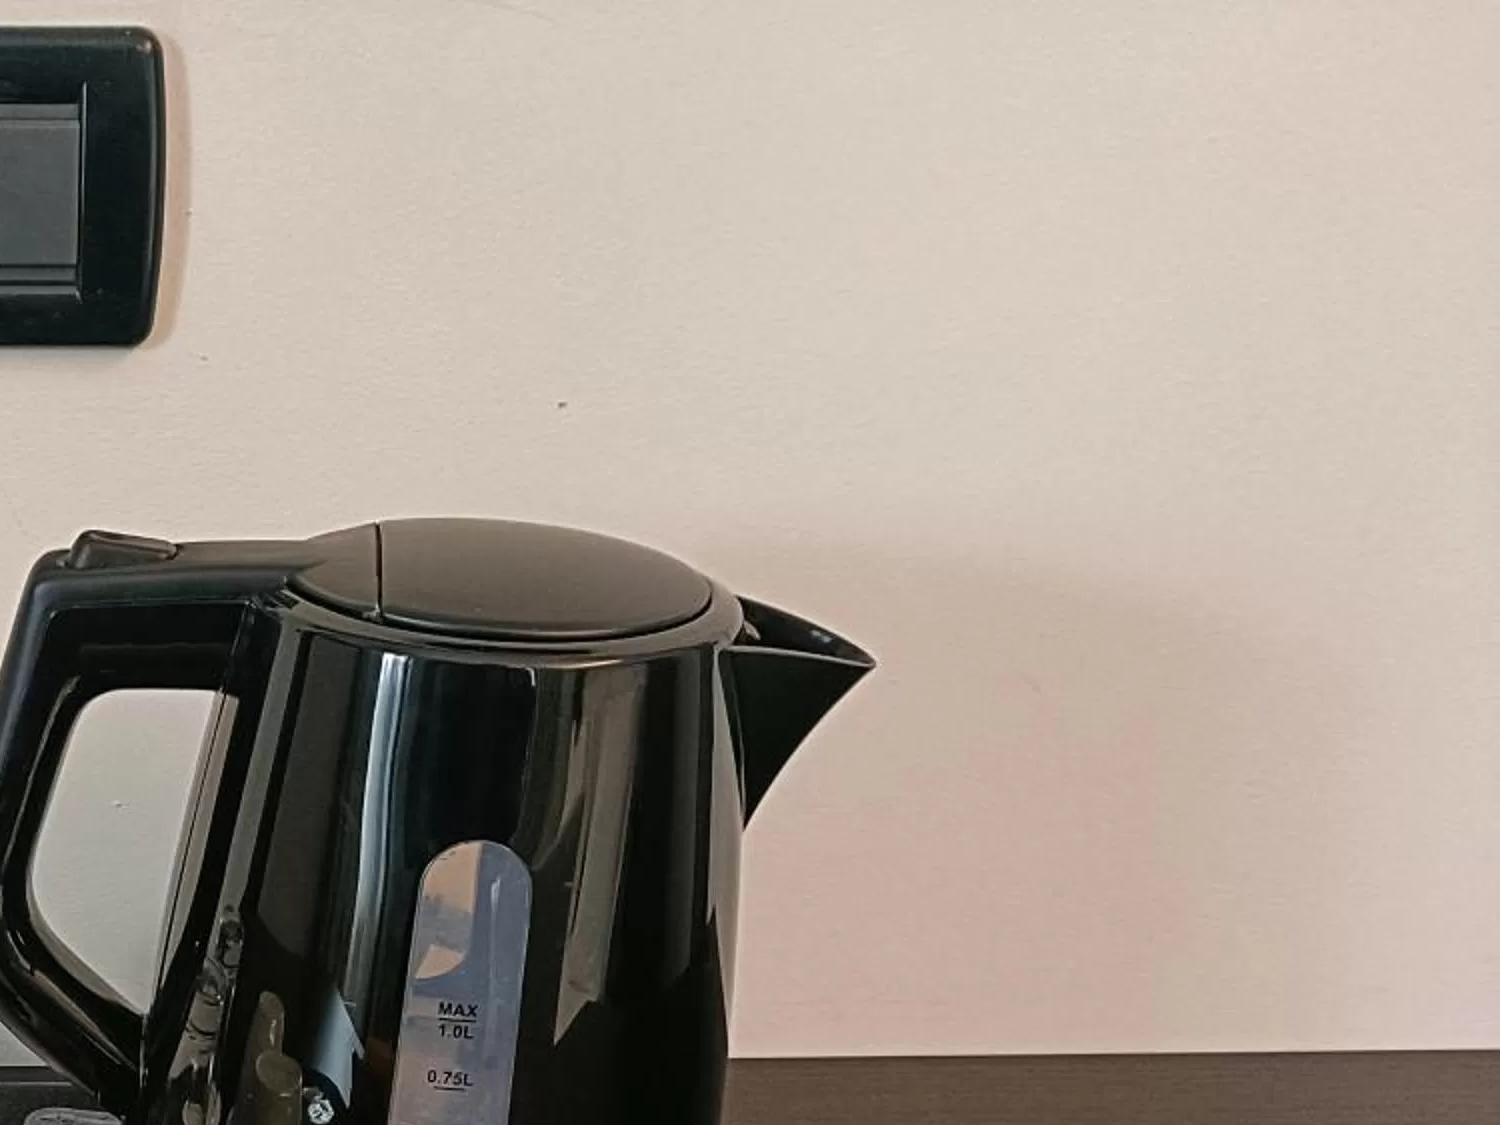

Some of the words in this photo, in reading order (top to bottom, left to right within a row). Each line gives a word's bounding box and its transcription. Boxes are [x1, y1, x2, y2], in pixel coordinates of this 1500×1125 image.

[438, 1002, 478, 1017] MAX
[438, 1024, 474, 1039] 1.0L
[427, 1069, 473, 1086] 0.75L
